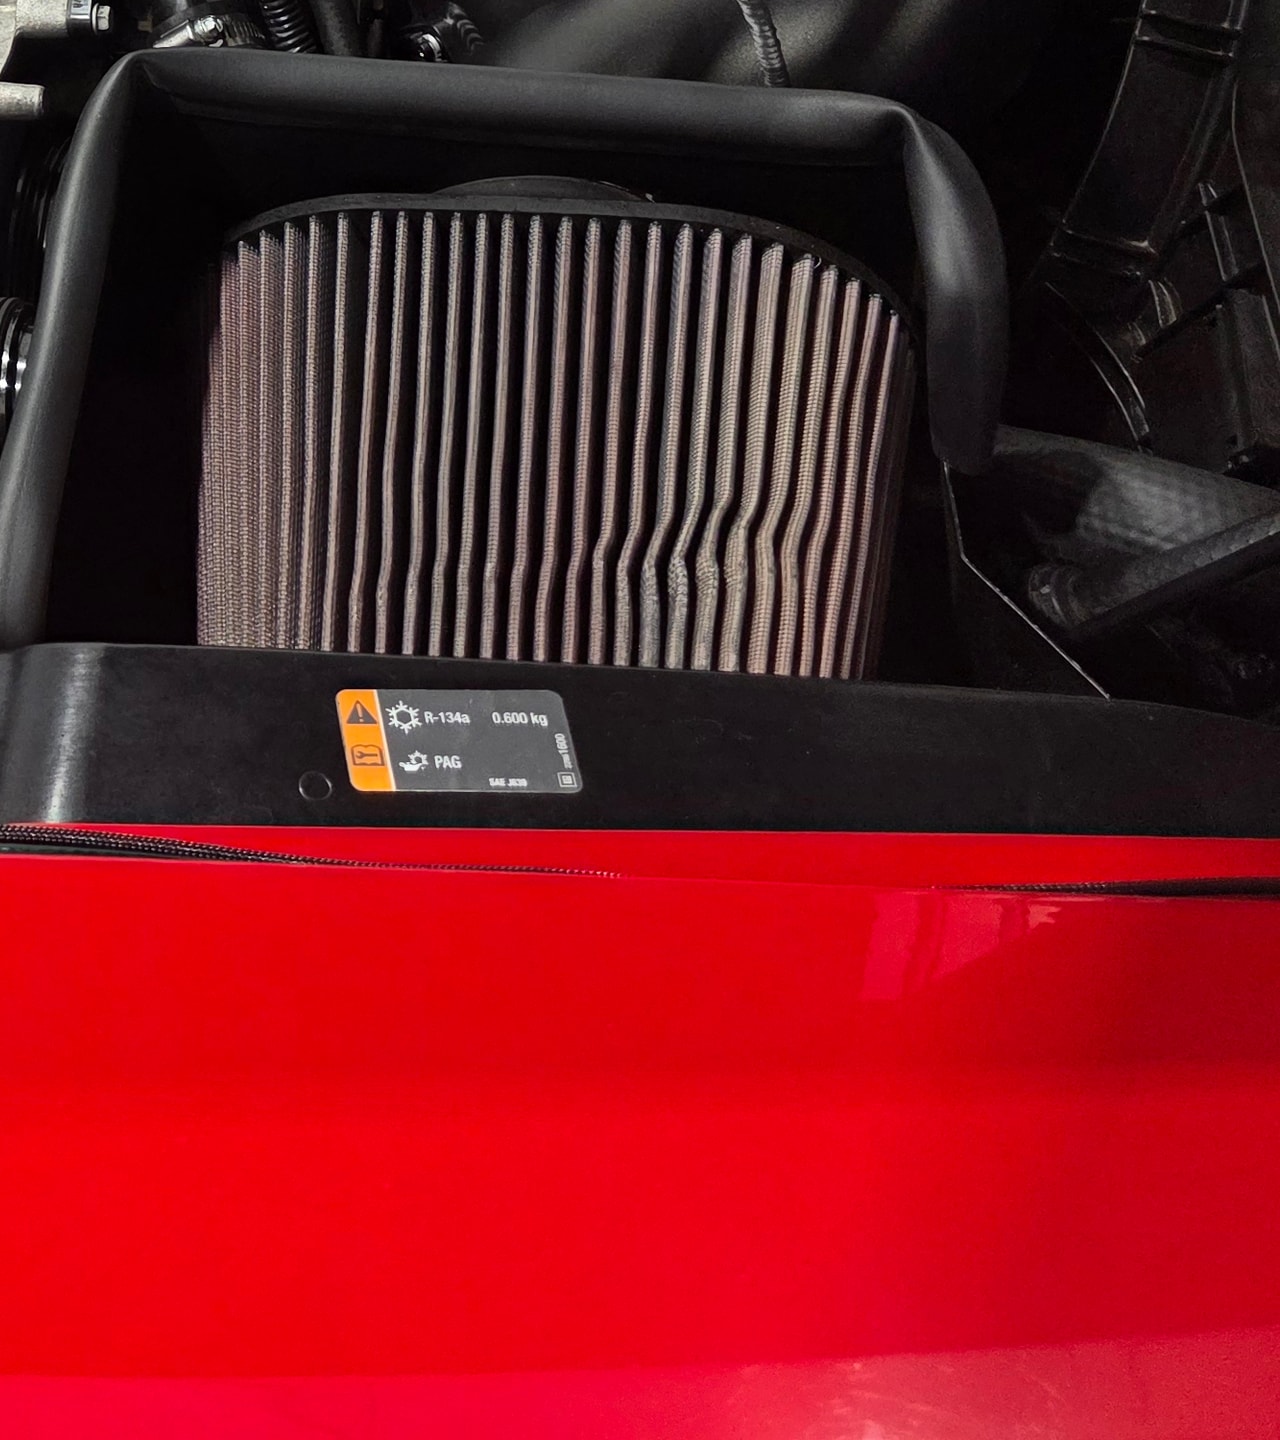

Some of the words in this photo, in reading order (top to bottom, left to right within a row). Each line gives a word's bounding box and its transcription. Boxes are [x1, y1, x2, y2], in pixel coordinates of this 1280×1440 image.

[424, 711, 471, 725] R-134a
[492, 711, 528, 725] 0.600
[530, 711, 549, 728] kg
[434, 755, 463, 770] PAG
